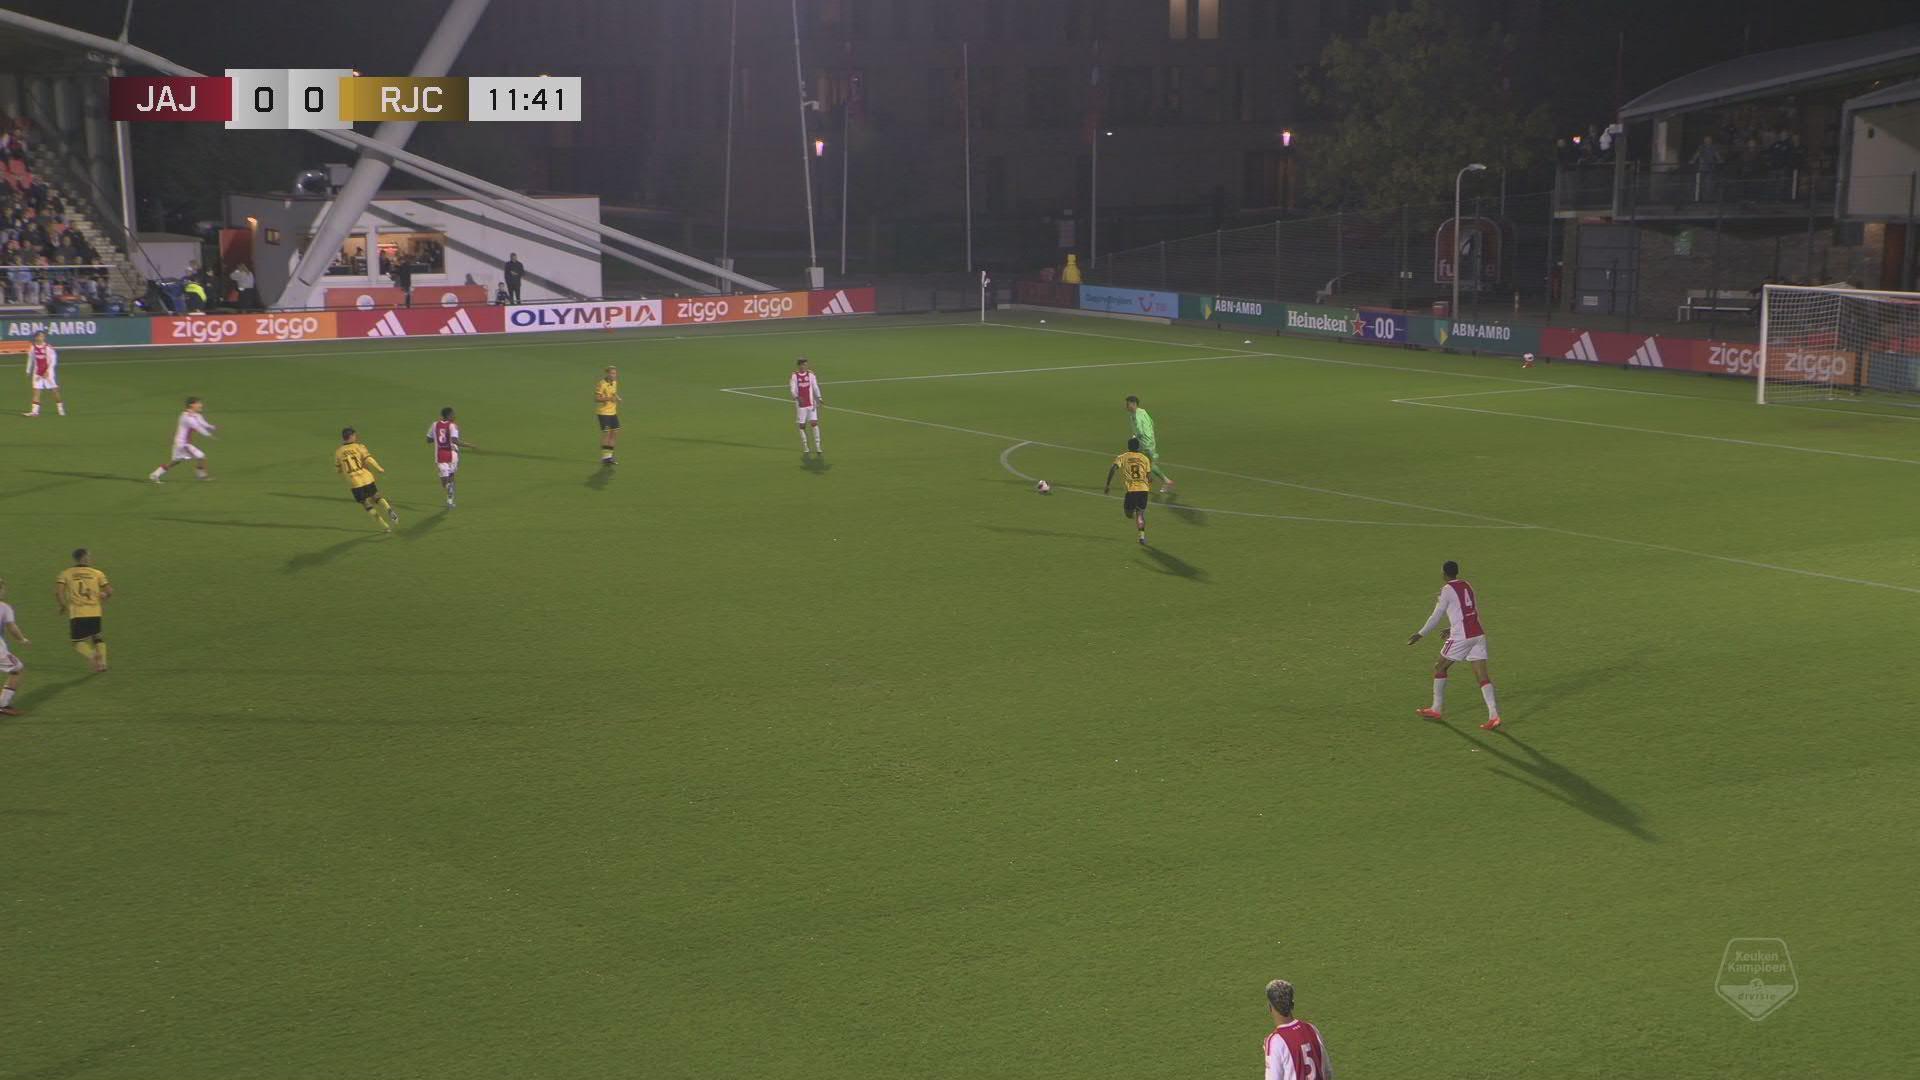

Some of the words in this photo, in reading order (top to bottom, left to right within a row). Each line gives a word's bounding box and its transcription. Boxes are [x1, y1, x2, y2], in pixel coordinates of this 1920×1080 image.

[510, 304, 656, 327] OLYMPIA
[677, 298, 729, 322] ziggo
[743, 295, 793, 318] ziggo
[172, 316, 238, 343] ziggo
[256, 314, 318, 340] ziggo
[1287, 310, 1347, 333] Heineken
[342, 455, 363, 474] 11
[1131, 464, 1141, 479] 8
[1464, 588, 1473, 609] 4
[1301, 1042, 1316, 1080] 5
